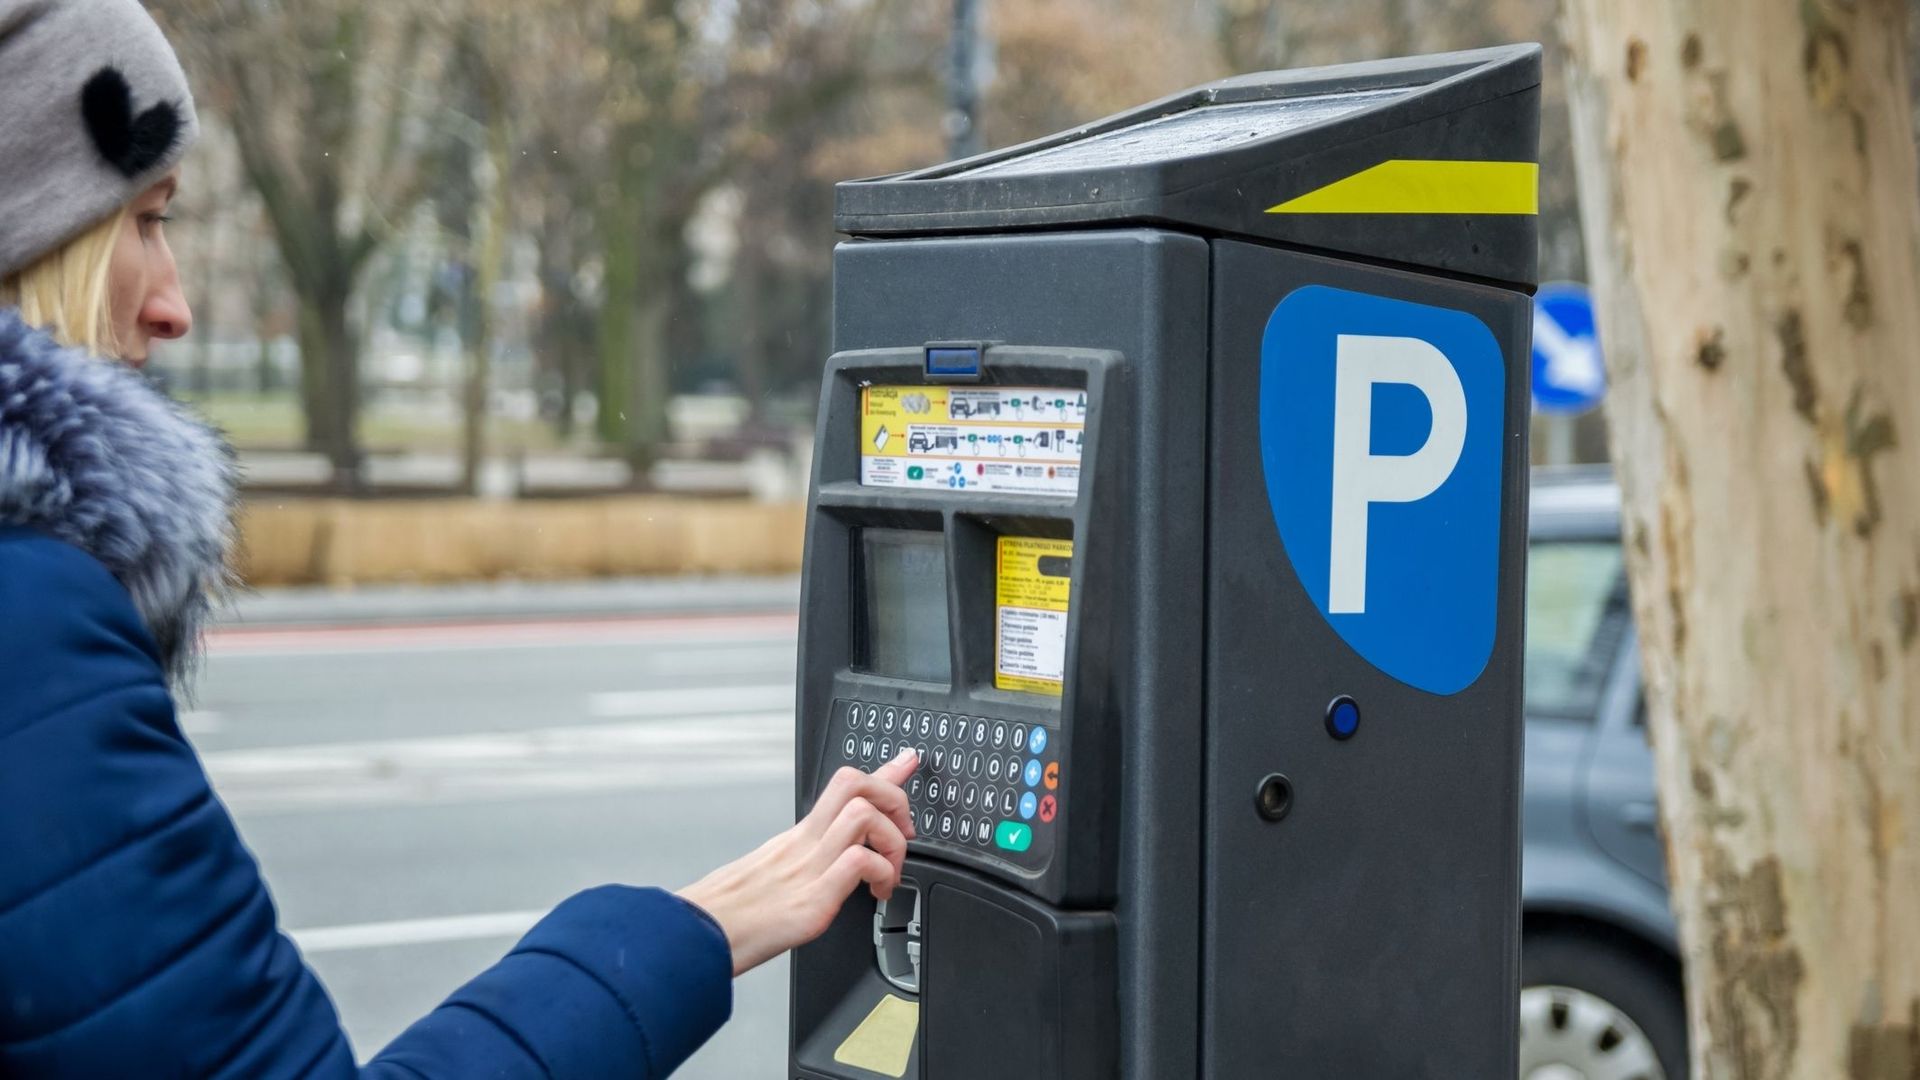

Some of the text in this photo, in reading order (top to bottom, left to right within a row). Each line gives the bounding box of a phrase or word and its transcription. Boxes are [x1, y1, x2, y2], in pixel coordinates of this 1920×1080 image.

[1328, 334, 1467, 614] P
[852, 708, 1023, 747] 1 2 3 4 5 6 7 8 9 0
[845, 739, 855, 754] Q
[862, 740, 874, 756] W
[881, 743, 889, 758] E
[917, 749, 925, 764] T
[935, 751, 943, 767] Y
[952, 754, 961, 769] U
[972, 757, 978, 772] I
[989, 759, 999, 775] O
[1009, 762, 1018, 777] P
[911, 780, 1012, 811] F G H J K L
[925, 814, 934, 829] V
[942, 817, 951, 832] B
[960, 820, 970, 836] N
[979, 823, 989, 839] M
